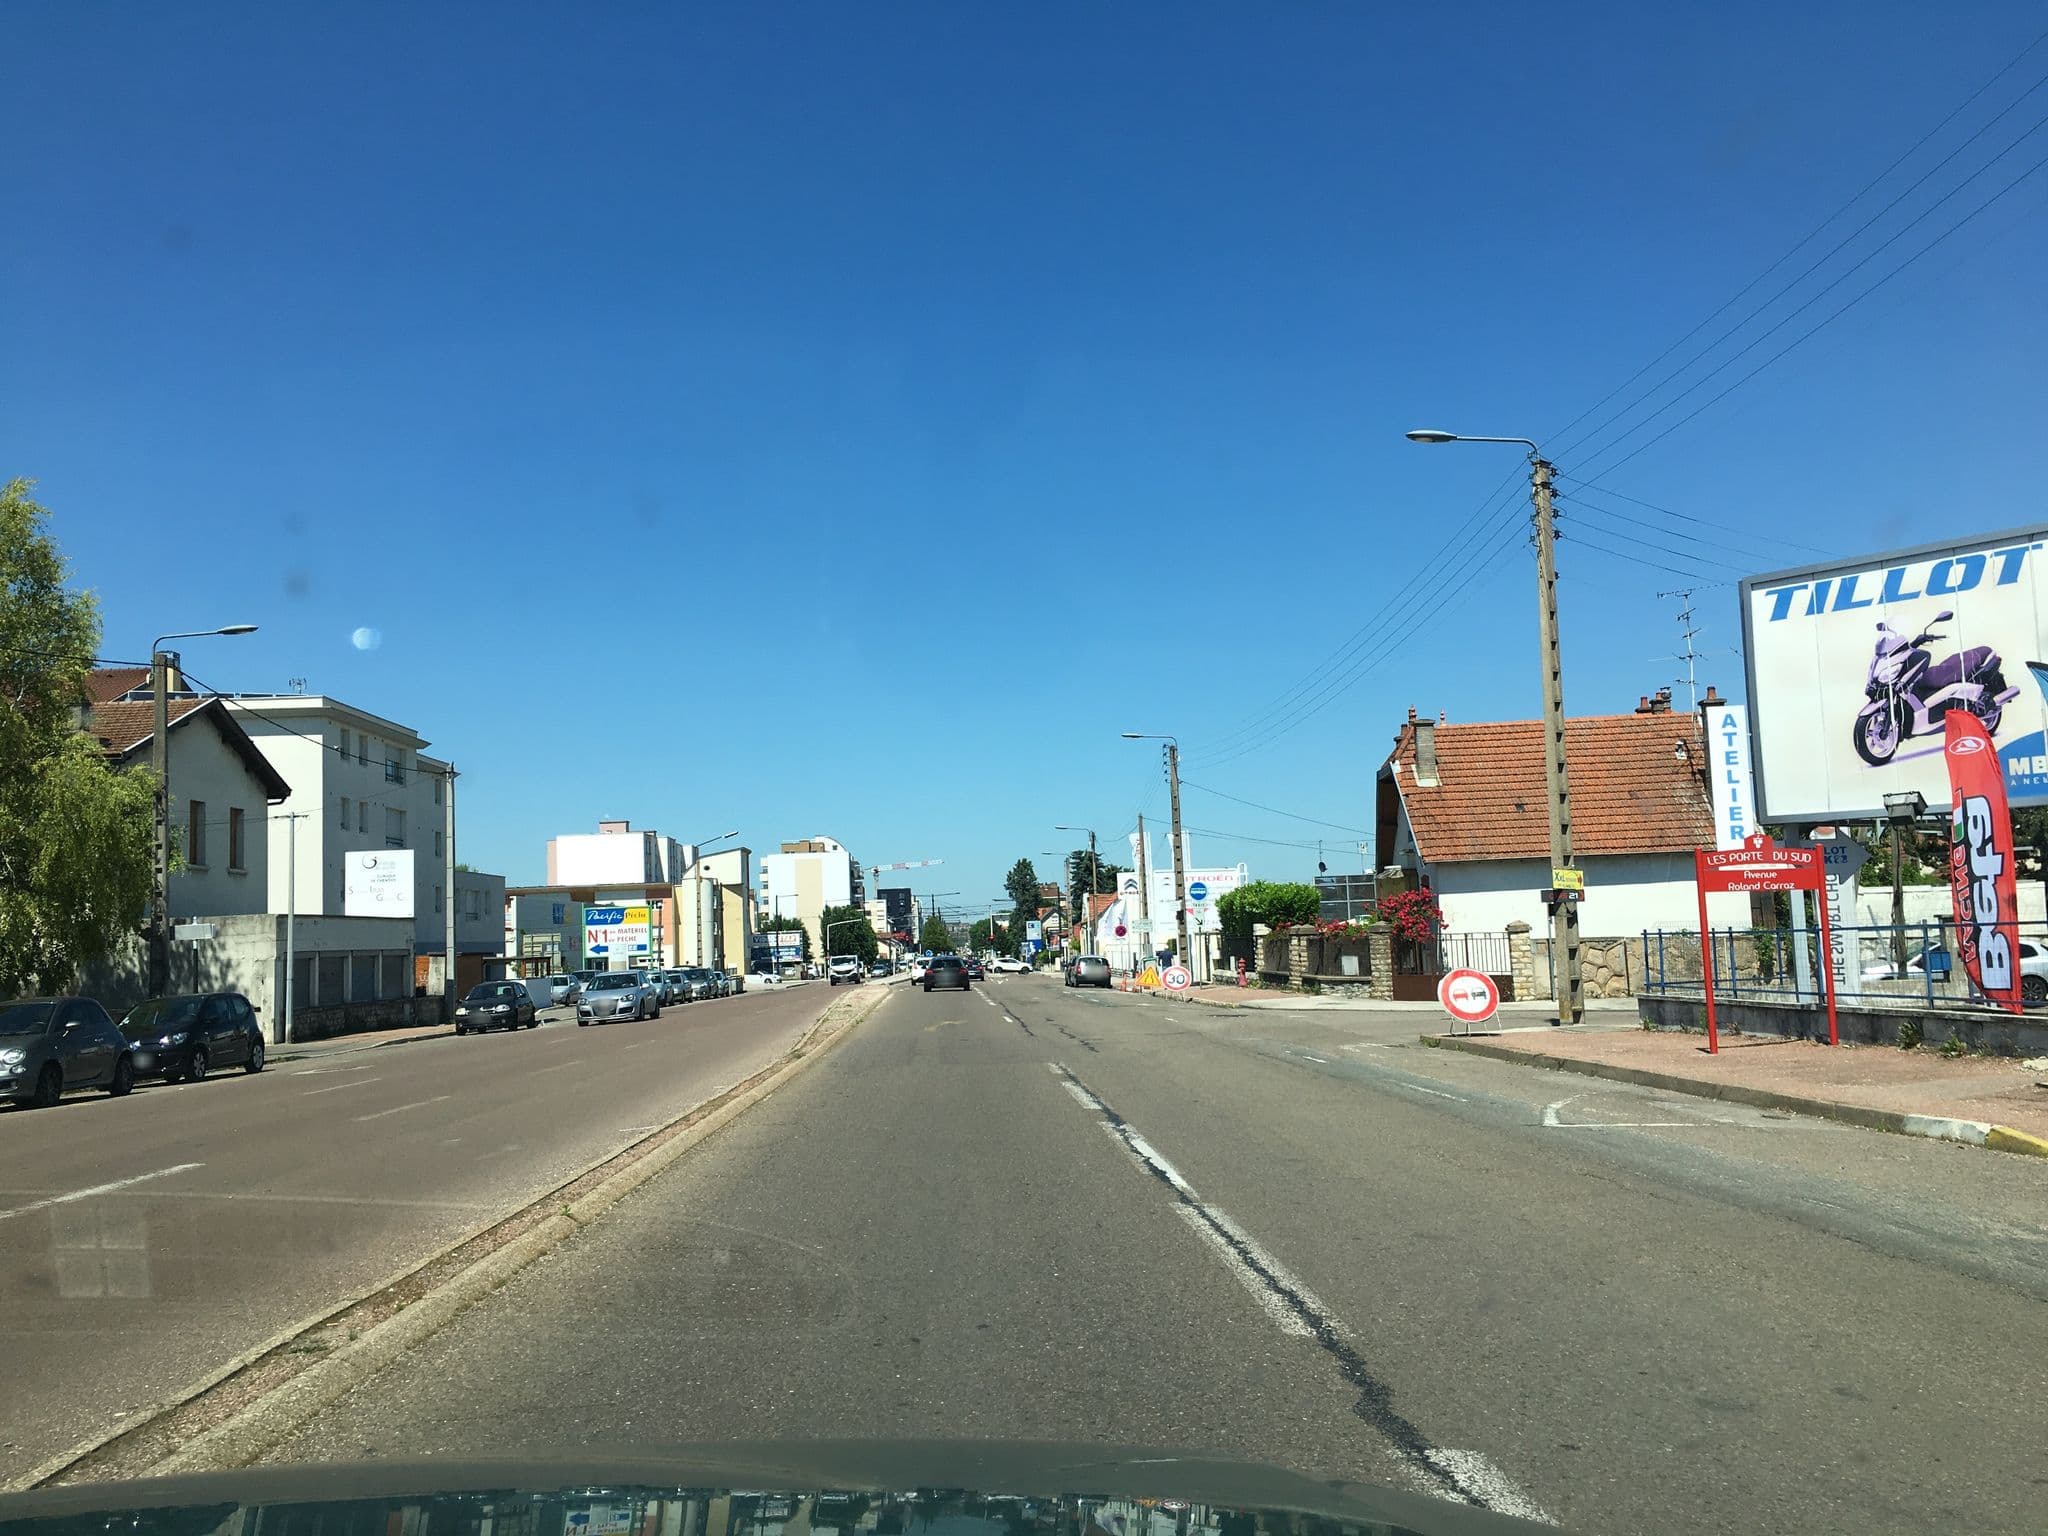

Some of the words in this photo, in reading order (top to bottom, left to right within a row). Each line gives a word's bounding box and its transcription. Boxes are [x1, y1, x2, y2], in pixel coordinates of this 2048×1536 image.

[1765, 543, 2043, 622] TILLOT
[1722, 713, 1745, 840] ATELIER
[1707, 855, 1727, 866] LES
[1729, 852, 1764, 863] PORTE
[1772, 851, 1788, 861] DU
[1790, 852, 1812, 863] SUD
[1185, 873, 1234, 882] ITROËN
[1743, 870, 1778, 879] Avenue
[1727, 881, 1761, 891] Roland
[1763, 881, 1796, 890] Carraz
[587, 910, 623, 924] Pacific
[1168, 973, 1186, 985] 30
